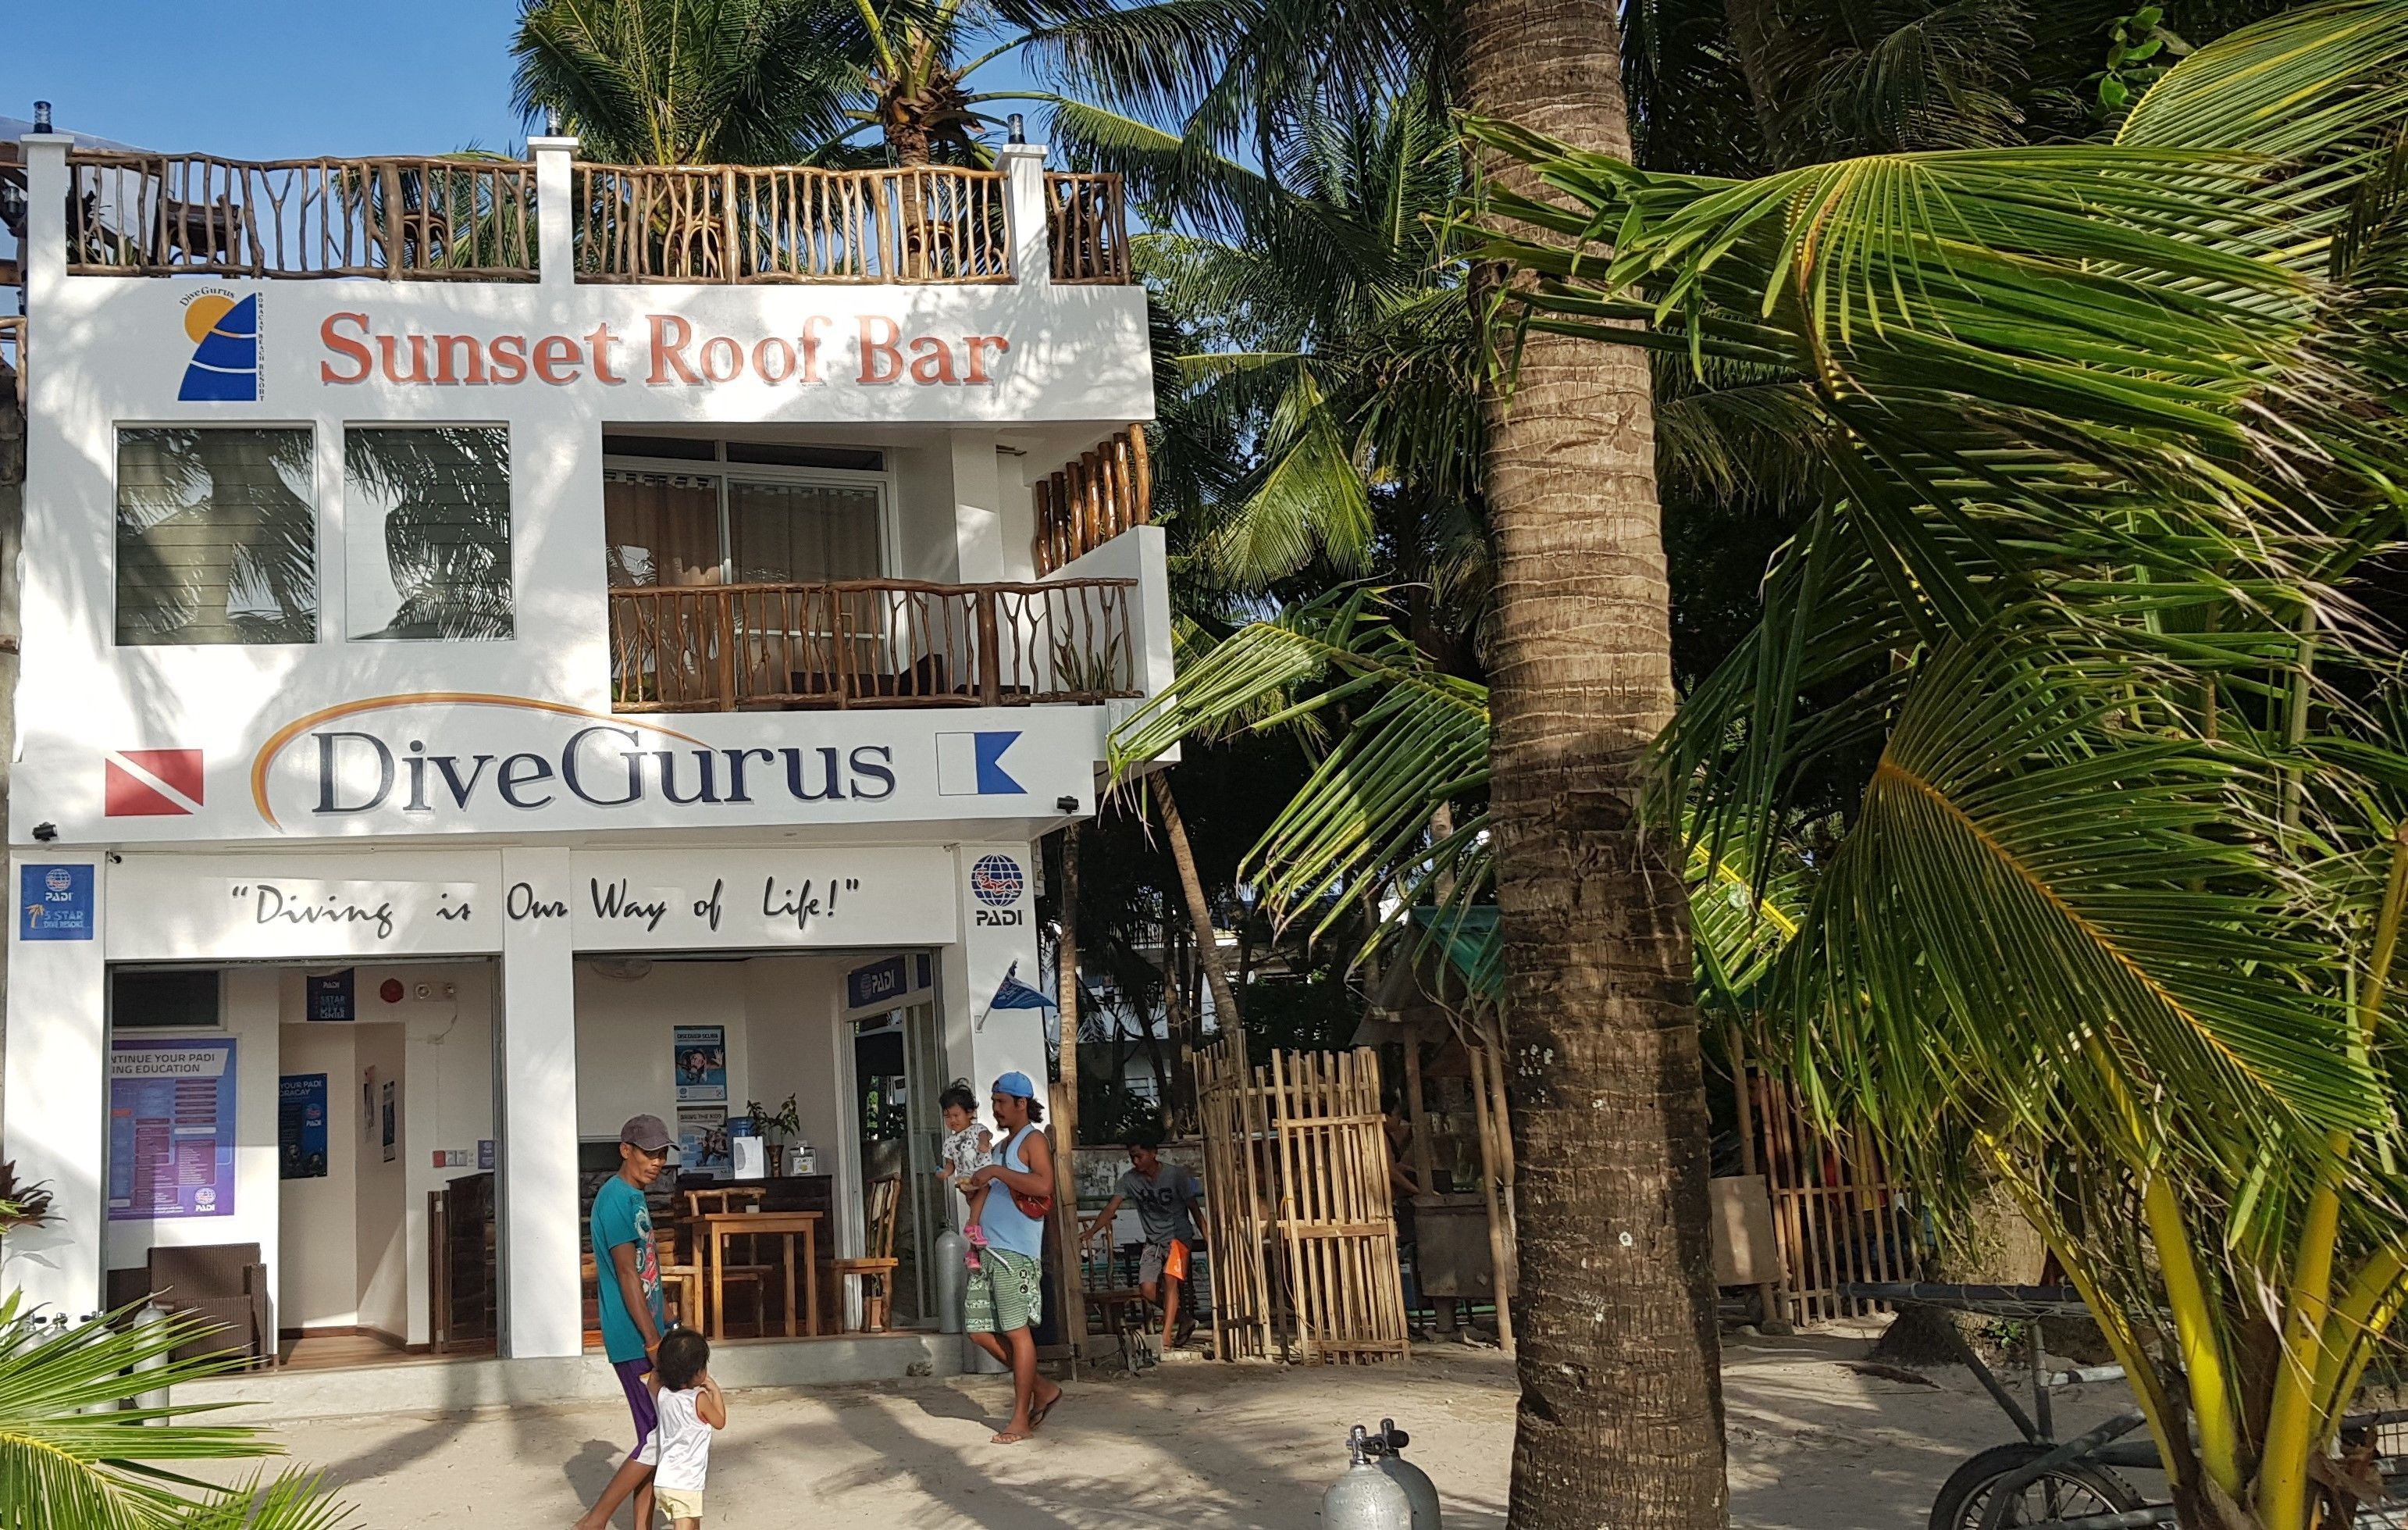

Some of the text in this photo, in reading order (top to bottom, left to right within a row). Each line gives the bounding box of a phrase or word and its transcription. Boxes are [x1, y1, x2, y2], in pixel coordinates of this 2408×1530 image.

[180, 286, 235, 307] DiveGurus
[319, 312, 1010, 387] Sunset Roof Bar
[312, 726, 897, 817] DiveGurus
[45, 892, 73, 901] PADI
[436, 893, 472, 922] is
[507, 882, 568, 920] Our
[590, 877, 668, 933] Way
[693, 878, 723, 931] of
[45, 910, 84, 920] 5 STAR
[976, 909, 1023, 926] PADI
[871, 969, 896, 994] PADI
[155, 1054, 185, 1063] YOUR
[189, 1053, 216, 1061] PADI
[136, 1064, 200, 1073] EDUCATION
[303, 1079, 322, 1088] PADI
